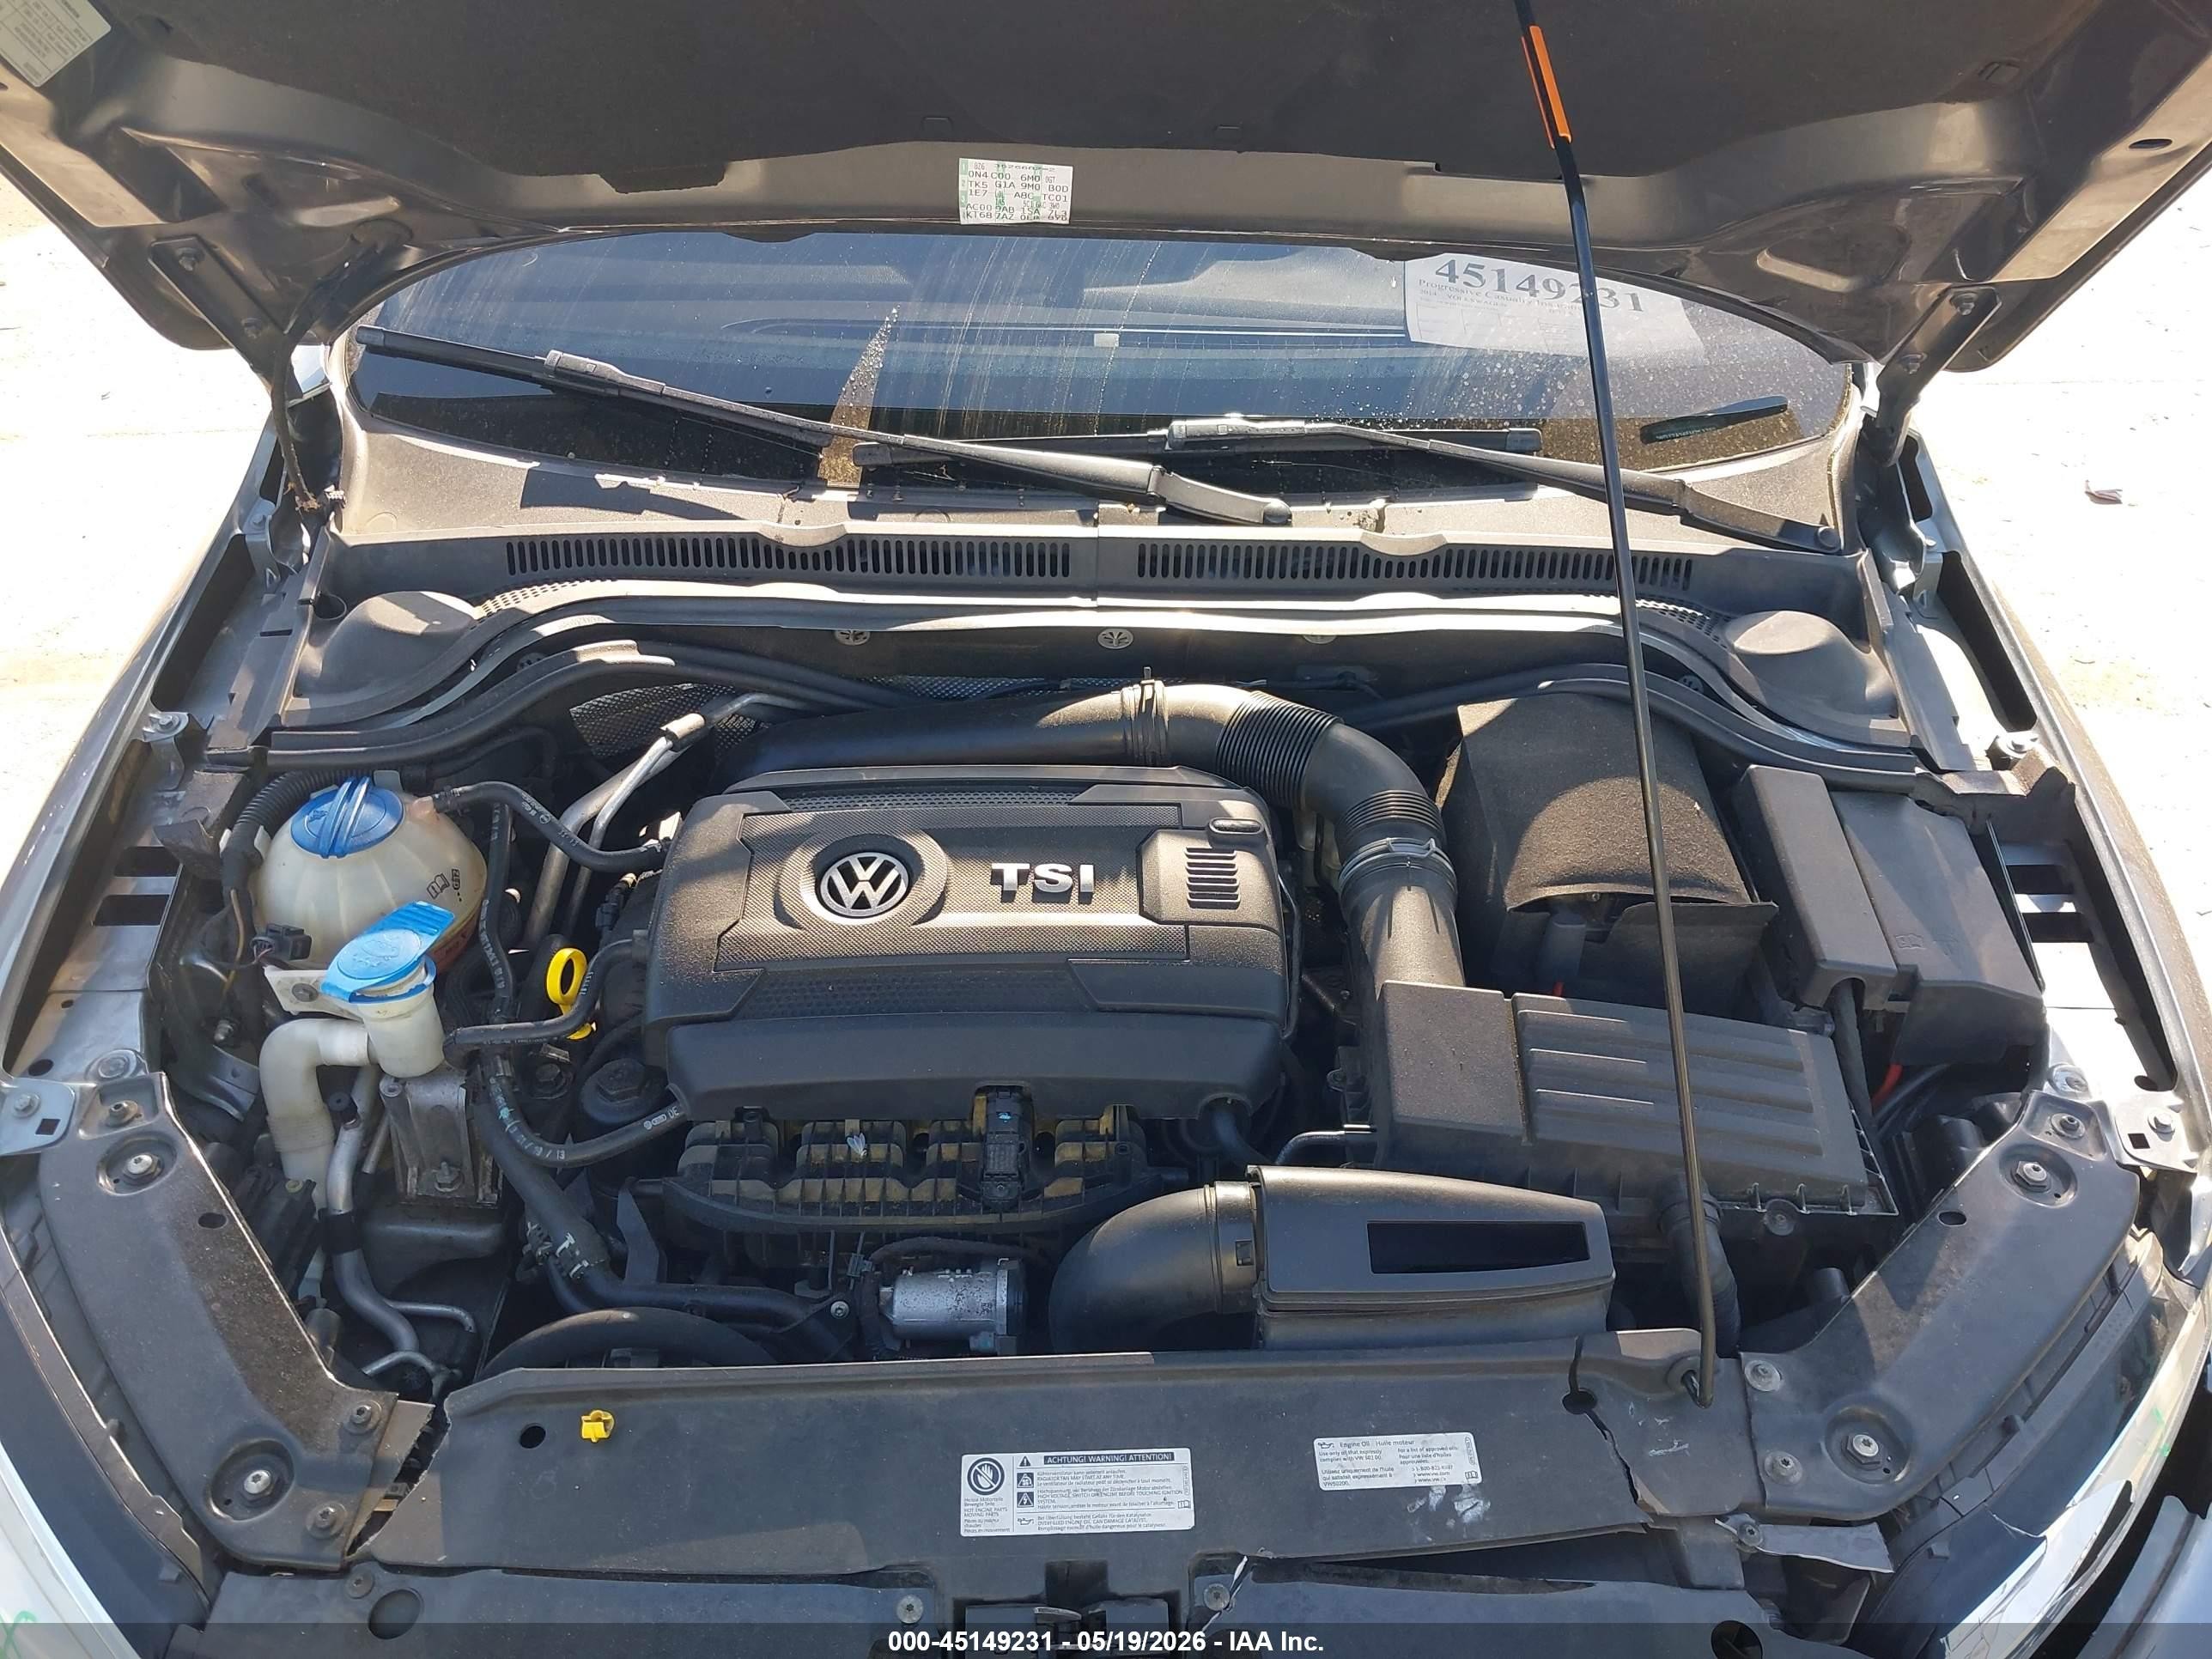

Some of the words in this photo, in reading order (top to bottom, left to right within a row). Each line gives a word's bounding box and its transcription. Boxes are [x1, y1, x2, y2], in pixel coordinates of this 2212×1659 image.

[1014, 191, 1035, 200] ABC
[1419, 278, 1482, 297] Progressive
[991, 862, 1095, 894] TSI
